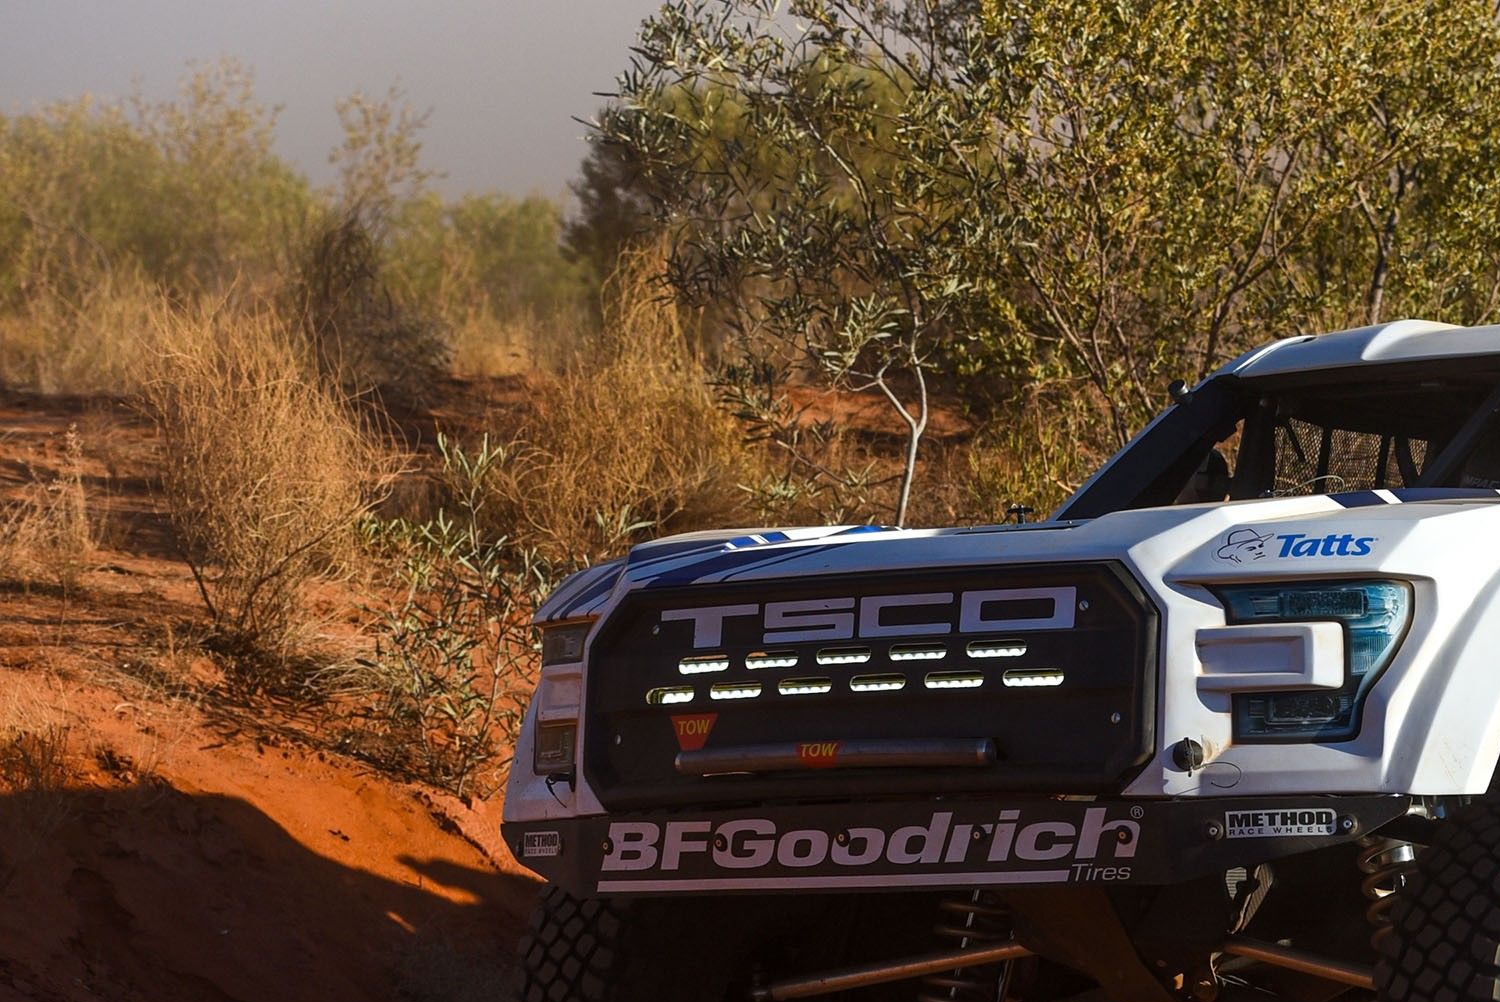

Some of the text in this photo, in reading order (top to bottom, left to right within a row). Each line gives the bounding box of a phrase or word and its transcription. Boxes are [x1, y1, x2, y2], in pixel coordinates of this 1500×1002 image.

[1277, 533, 1374, 558] Tatts
[661, 587, 1076, 649] TSCO
[678, 719, 711, 736] TOW
[800, 743, 837, 757] TOW
[1228, 811, 1334, 827] METHOD
[600, 807, 1140, 871] BFGoodrich
[1229, 826, 1333, 836] RACE WHEELS
[525, 834, 558, 847] METHOD
[1071, 862, 1132, 882] Tires
